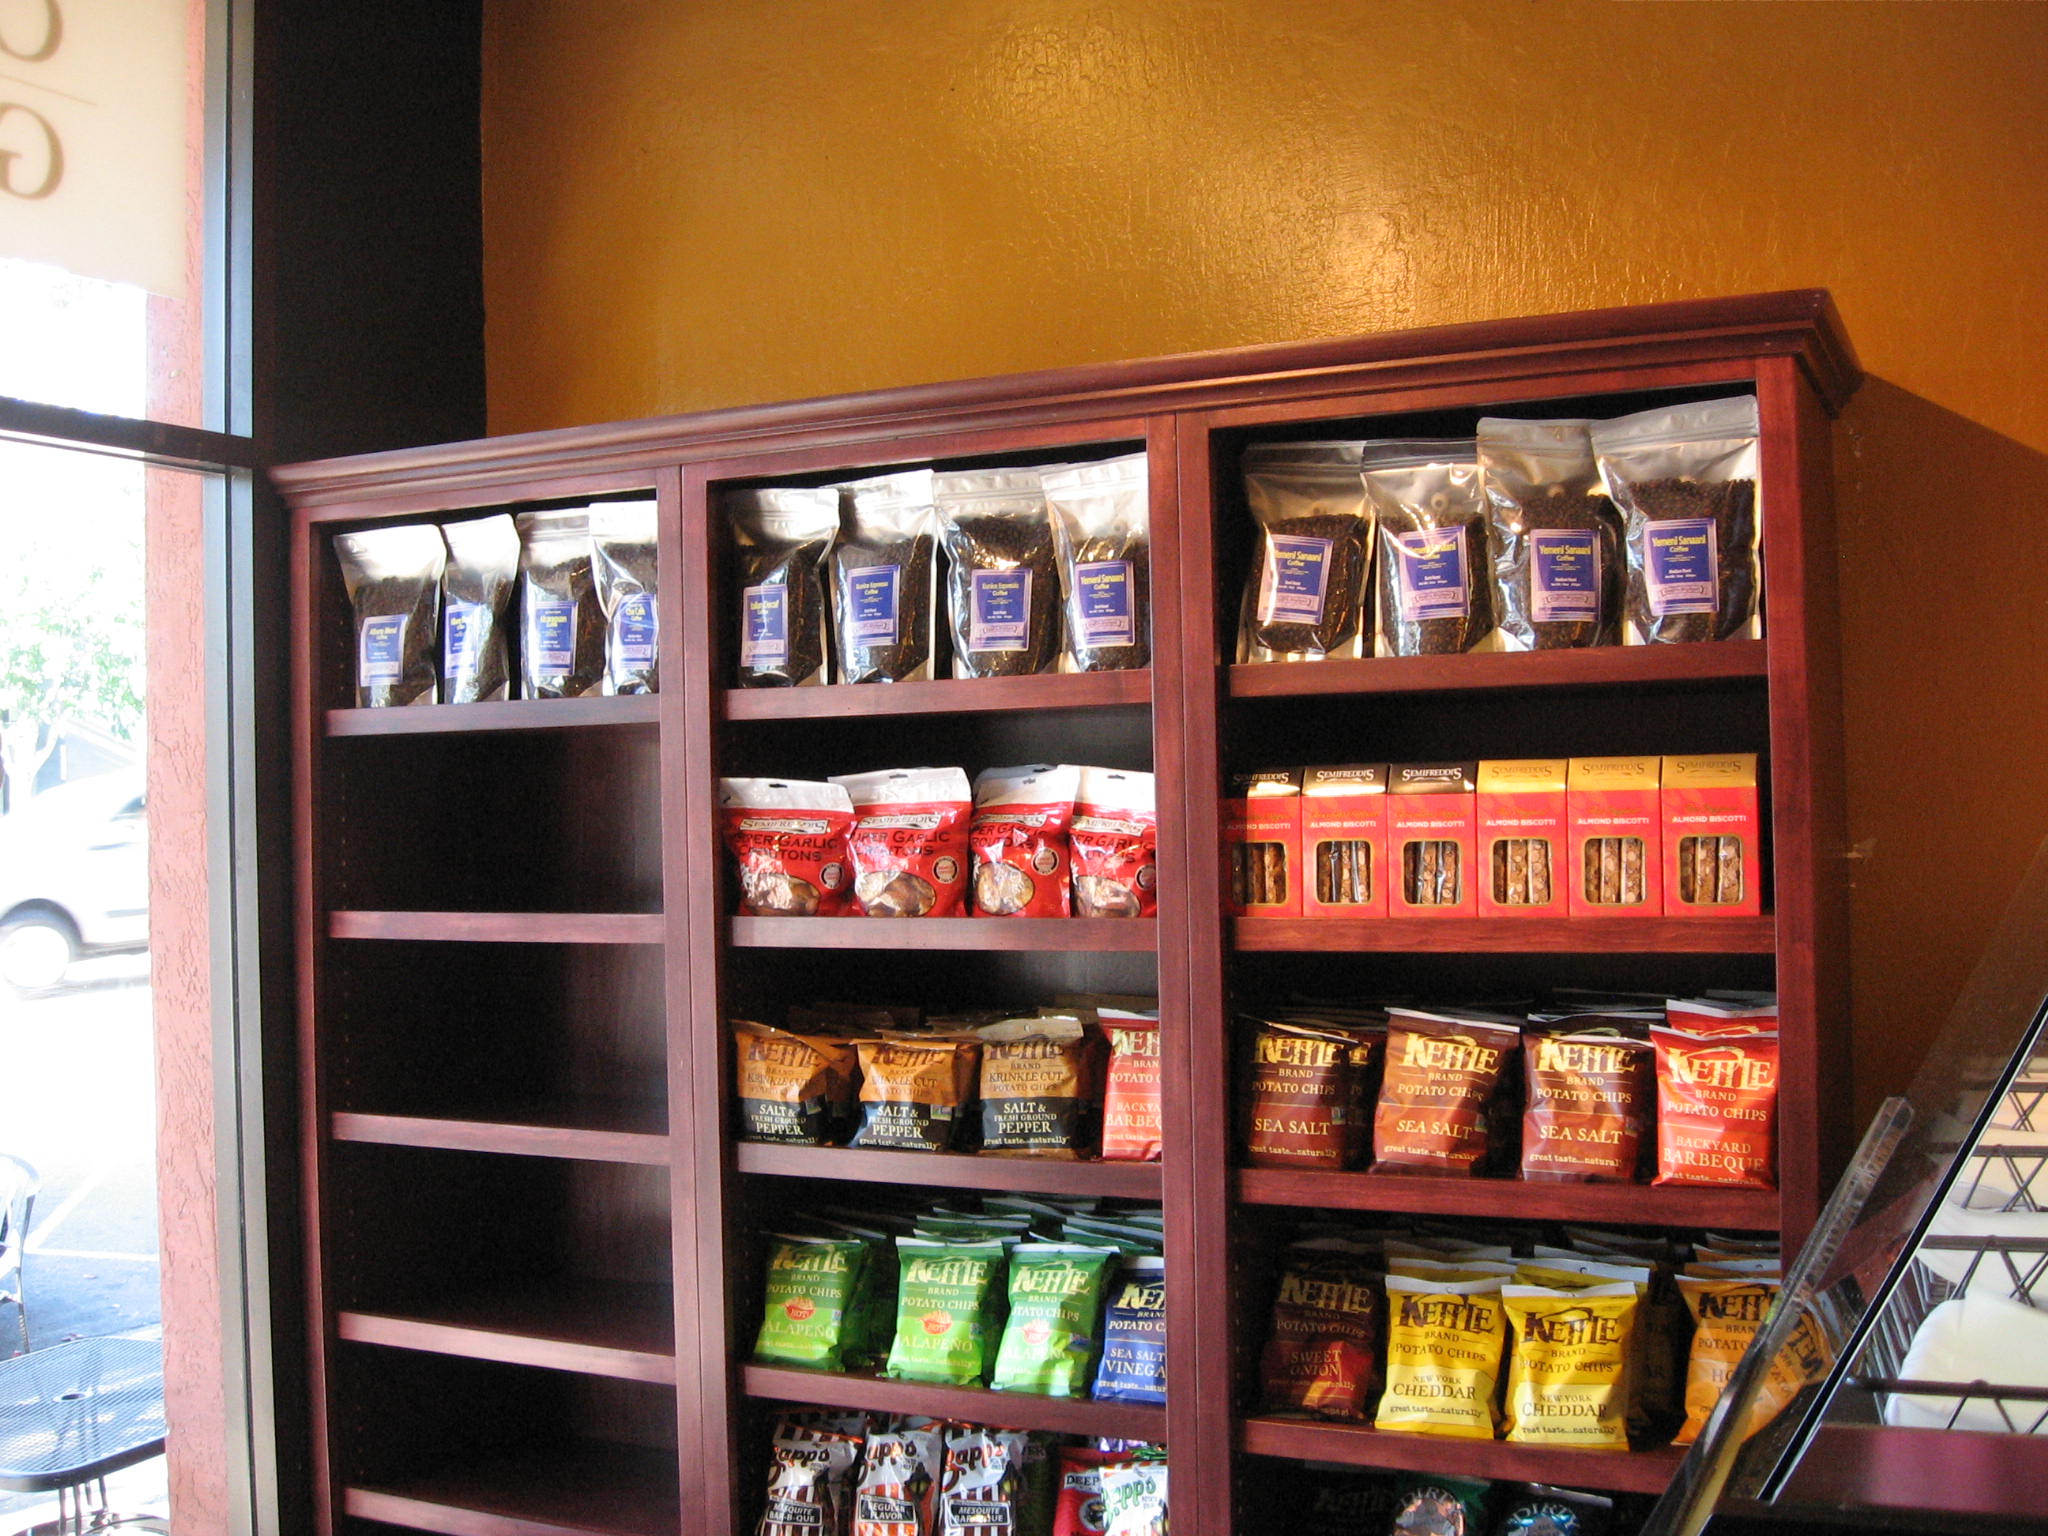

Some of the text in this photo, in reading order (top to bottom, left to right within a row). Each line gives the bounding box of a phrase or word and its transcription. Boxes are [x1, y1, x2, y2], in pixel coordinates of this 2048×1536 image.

[1254, 1033, 1345, 1067] KETTLE
[1399, 1031, 1500, 1075] KETTLE
[1533, 1037, 1638, 1074] KETTLE
[1010, 1062, 1041, 1070] BRAND
[1133, 1060, 1159, 1068] BRAN
[1667, 1045, 1776, 1091] KETTLE
[989, 1070, 1063, 1082] KRINKLE CUT
[1110, 1073, 1153, 1083] POTATO
[1278, 1068, 1313, 1079] BRAND
[1428, 1072, 1463, 1082] BRAND
[1251, 1081, 1335, 1096] POTATO CHIPS
[1566, 1076, 1605, 1087] BRAND
[1397, 1083, 1485, 1102] POTATO CHIPS
[1536, 1087, 1632, 1104] POTATO CHIPS
[1695, 1089, 1737, 1102] BRAND
[760, 1103, 786, 1116] SALT
[877, 1104, 919, 1118] SALT &
[1003, 1102, 1046, 1114] SALT &
[1116, 1102, 1161, 1112] BACKYA
[1666, 1101, 1768, 1122] POTATO CHIPS
[893, 1117, 929, 1127] GROUND
[1020, 1113, 1057, 1122] GROUND
[756, 1121, 804, 1136] PEPPER
[873, 1123, 923, 1138] PEPPER
[998, 1121, 1052, 1134] PEPPER
[1254, 1118, 1331, 1136] SEA SALT
[1396, 1119, 1474, 1140] SEA SALT
[1539, 1124, 1623, 1145] SEA SALT
[1676, 1135, 1752, 1154] BACKYARD
[1663, 1147, 1765, 1173] BARBEQUE
[772, 1243, 850, 1273] KETTLE
[790, 1273, 820, 1282] BRAND
[905, 1256, 988, 1286] KETTLE
[1011, 1260, 1092, 1296] KETTLE
[766, 1284, 842, 1299] POTATO CHIPS
[928, 1287, 959, 1296] BRAND
[1028, 1295, 1057, 1303] BRAND
[1278, 1272, 1373, 1314] KETTLE
[901, 1297, 979, 1311] POTATO CHIPS
[1046, 1307, 1080, 1322] CHIPS
[1398, 1294, 1496, 1335] KETTLE
[1108, 1320, 1153, 1331] POTATO
[1277, 1319, 1327, 1334] POTATO
[1521, 1306, 1621, 1347] KETTLE
[1726, 1324, 1756, 1334] BRAN
[1425, 1331, 1460, 1342] BRAND
[1110, 1347, 1165, 1362] SEA SALT
[1291, 1349, 1343, 1363] SWEET
[1395, 1342, 1487, 1361] POTATO CHIPS
[1550, 1347, 1586, 1358] BRAND
[1105, 1360, 1166, 1378] VINEGA
[1290, 1362, 1341, 1377] ONION
[1519, 1359, 1614, 1374] POTATO CHIPS
[1413, 1375, 1461, 1384] NEW YORK
[1392, 1383, 1477, 1399] CHEDDAR
[1537, 1393, 1592, 1402] NEW YORK
[1521, 1402, 1607, 1418] CHEDDAR
[1065, 1474, 1100, 1487] DEEP
[958, 1506, 1000, 1515] MESQUITE
